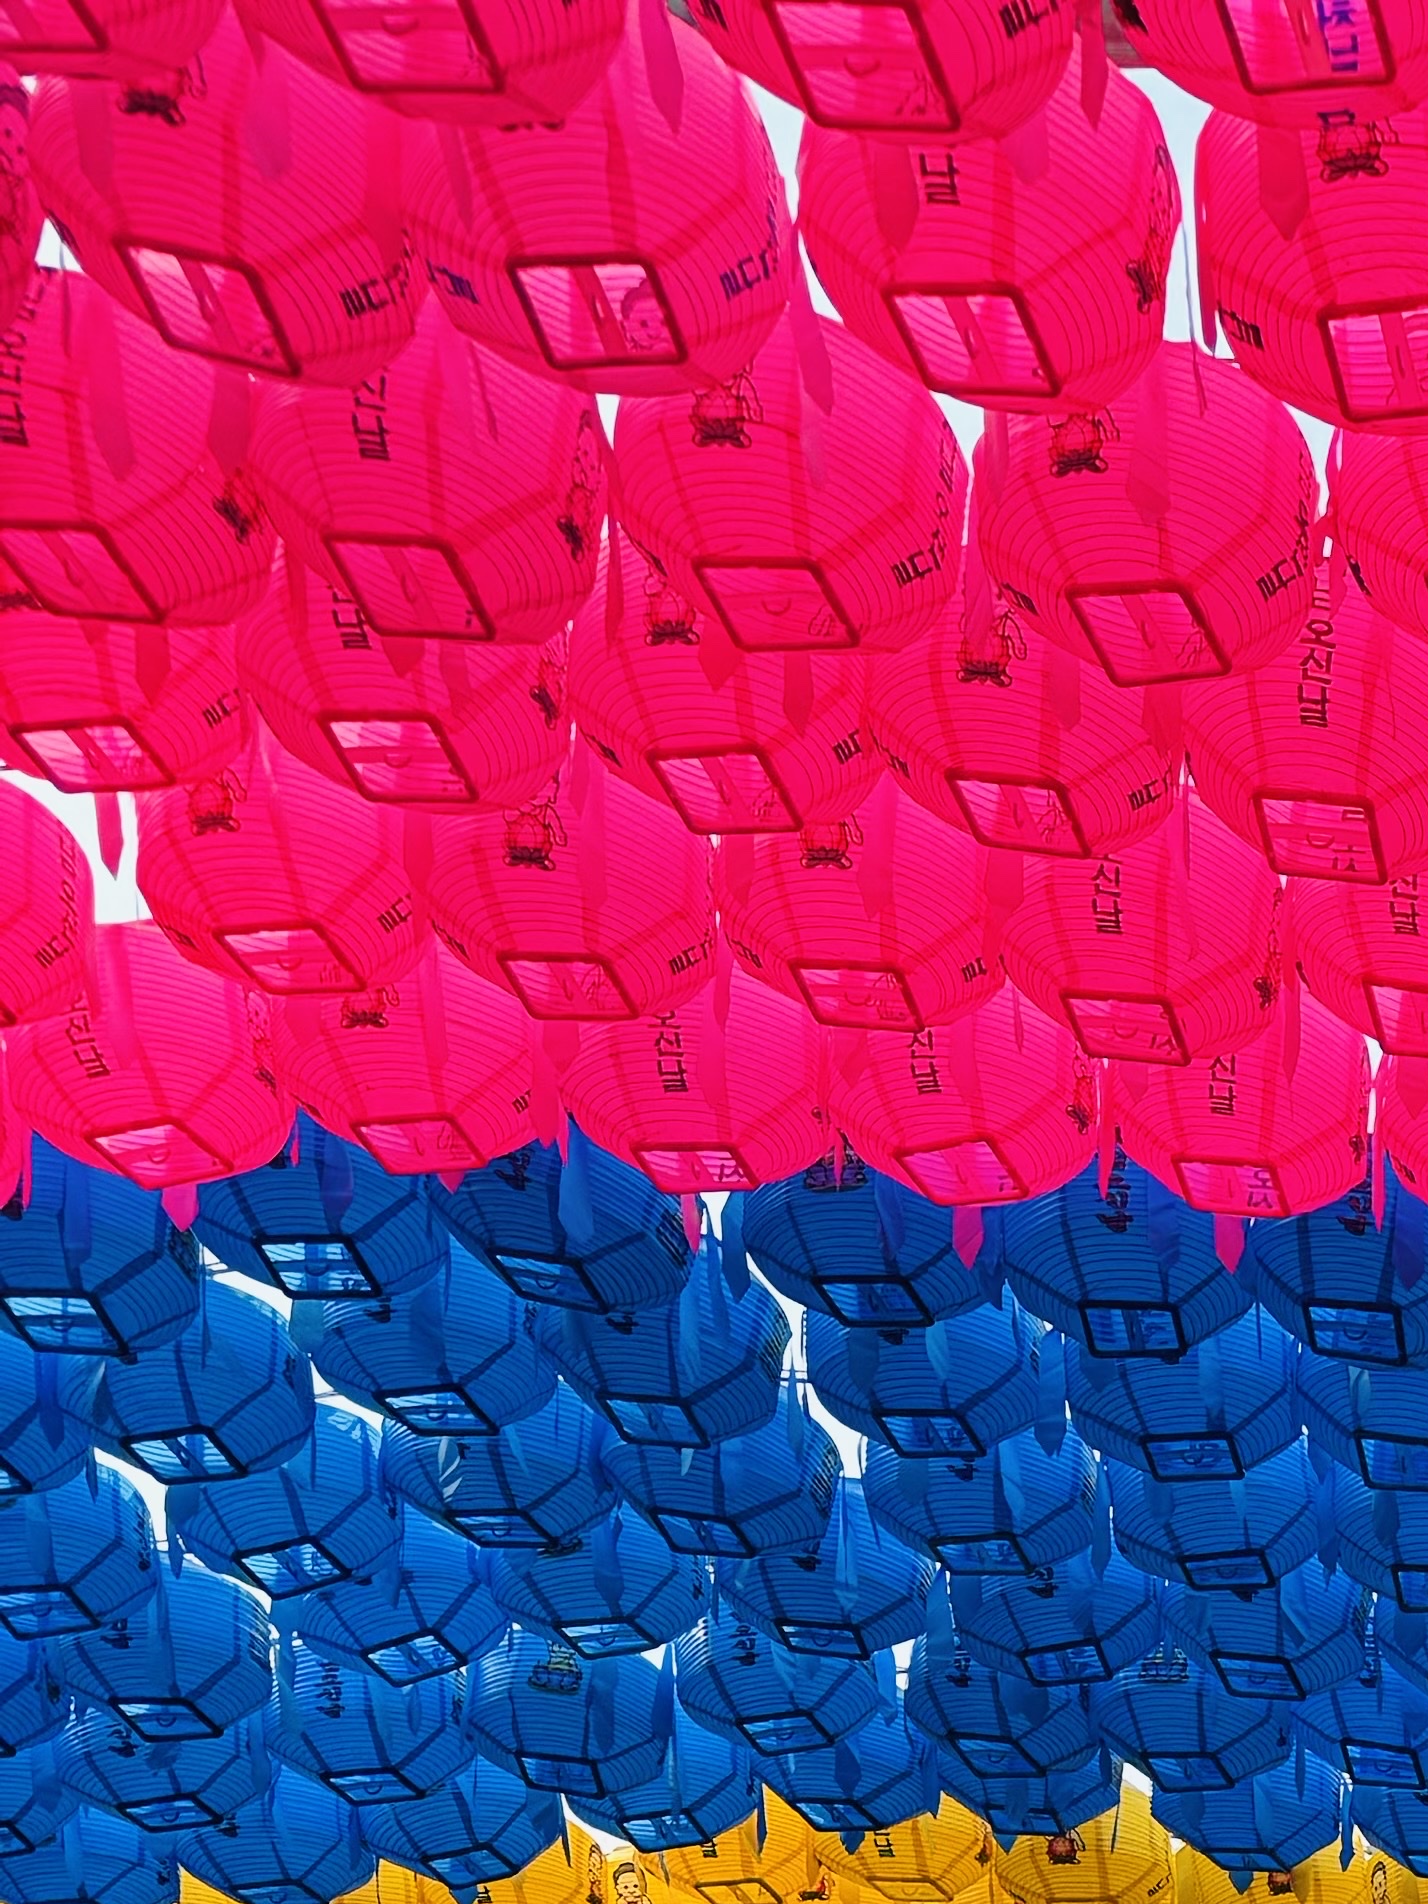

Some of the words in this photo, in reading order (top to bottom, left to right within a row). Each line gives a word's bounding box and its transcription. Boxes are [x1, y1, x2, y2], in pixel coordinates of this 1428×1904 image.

[1298, 620, 1336, 728] 오신날
[1390, 874, 1421, 936] 신날
[908, 1030, 941, 1095] 신날
[1209, 1055, 1237, 1116] 신날
